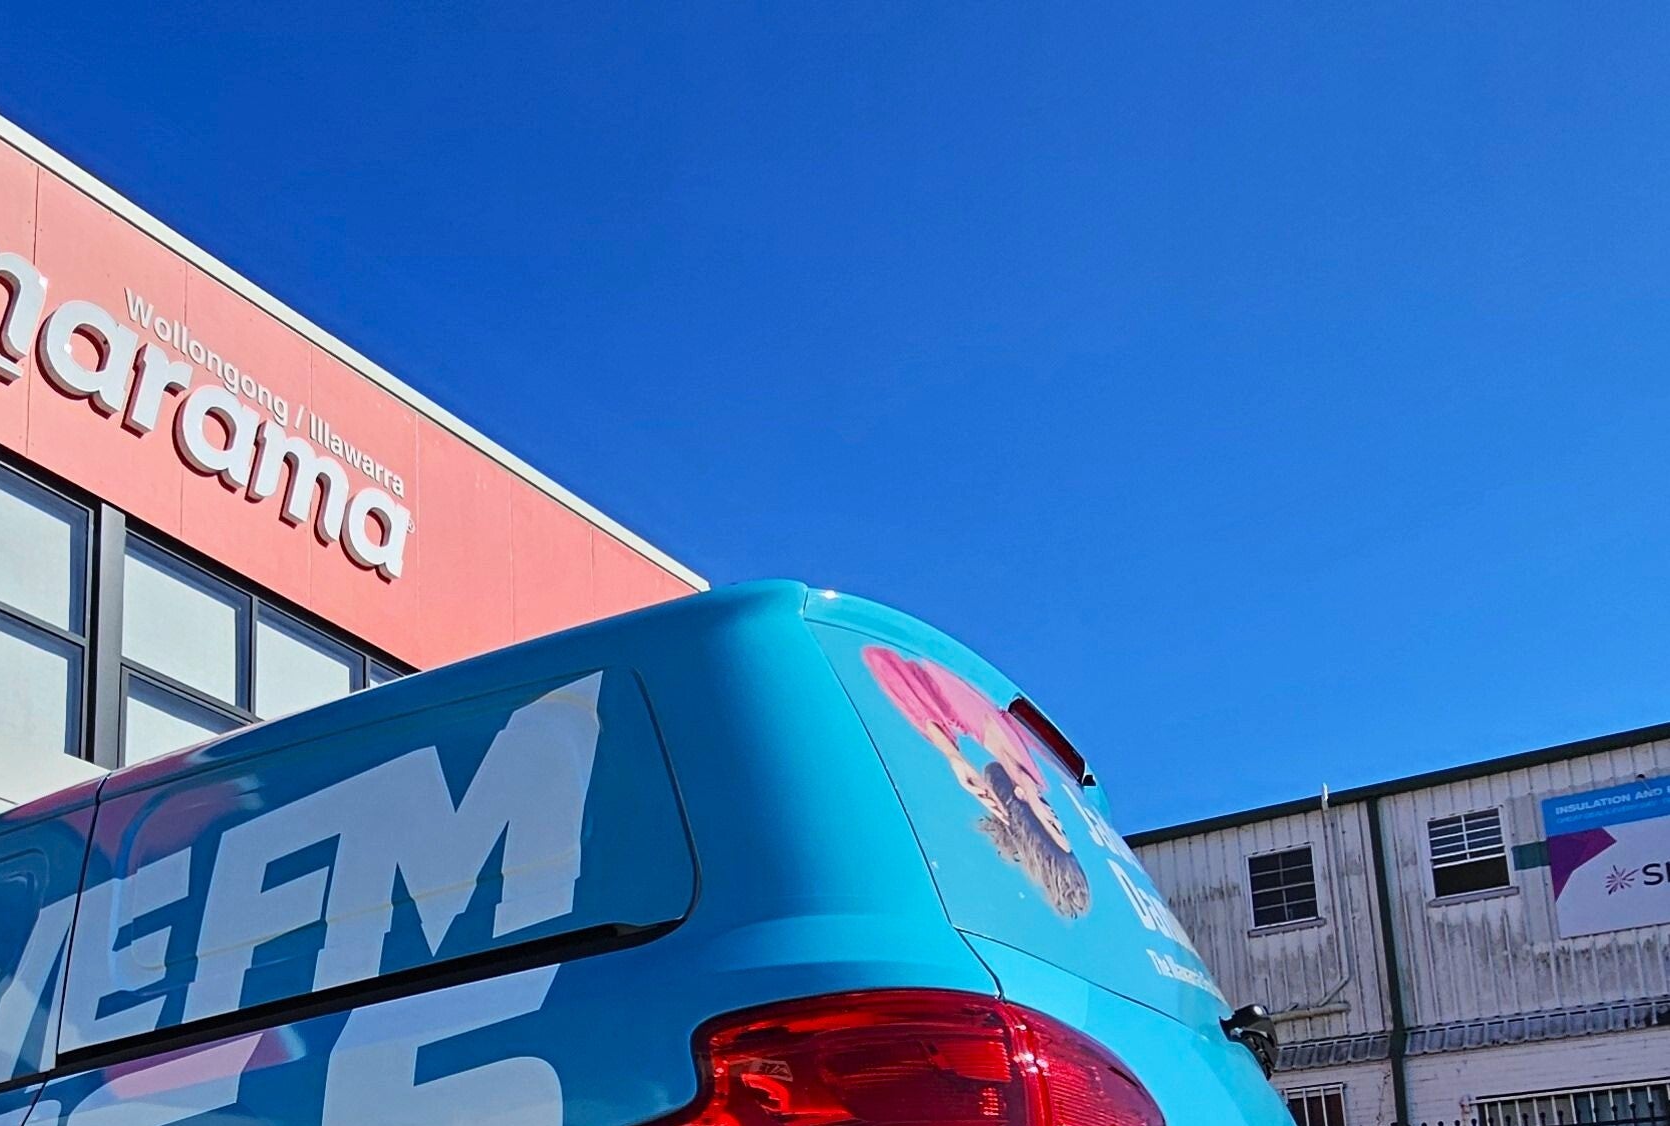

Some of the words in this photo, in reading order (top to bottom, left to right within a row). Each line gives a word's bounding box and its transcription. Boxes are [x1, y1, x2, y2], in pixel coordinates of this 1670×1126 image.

[124, 287, 289, 427] Wollongong
[309, 412, 405, 499] Illawarra
[1555, 794, 1631, 815] INSULATION
